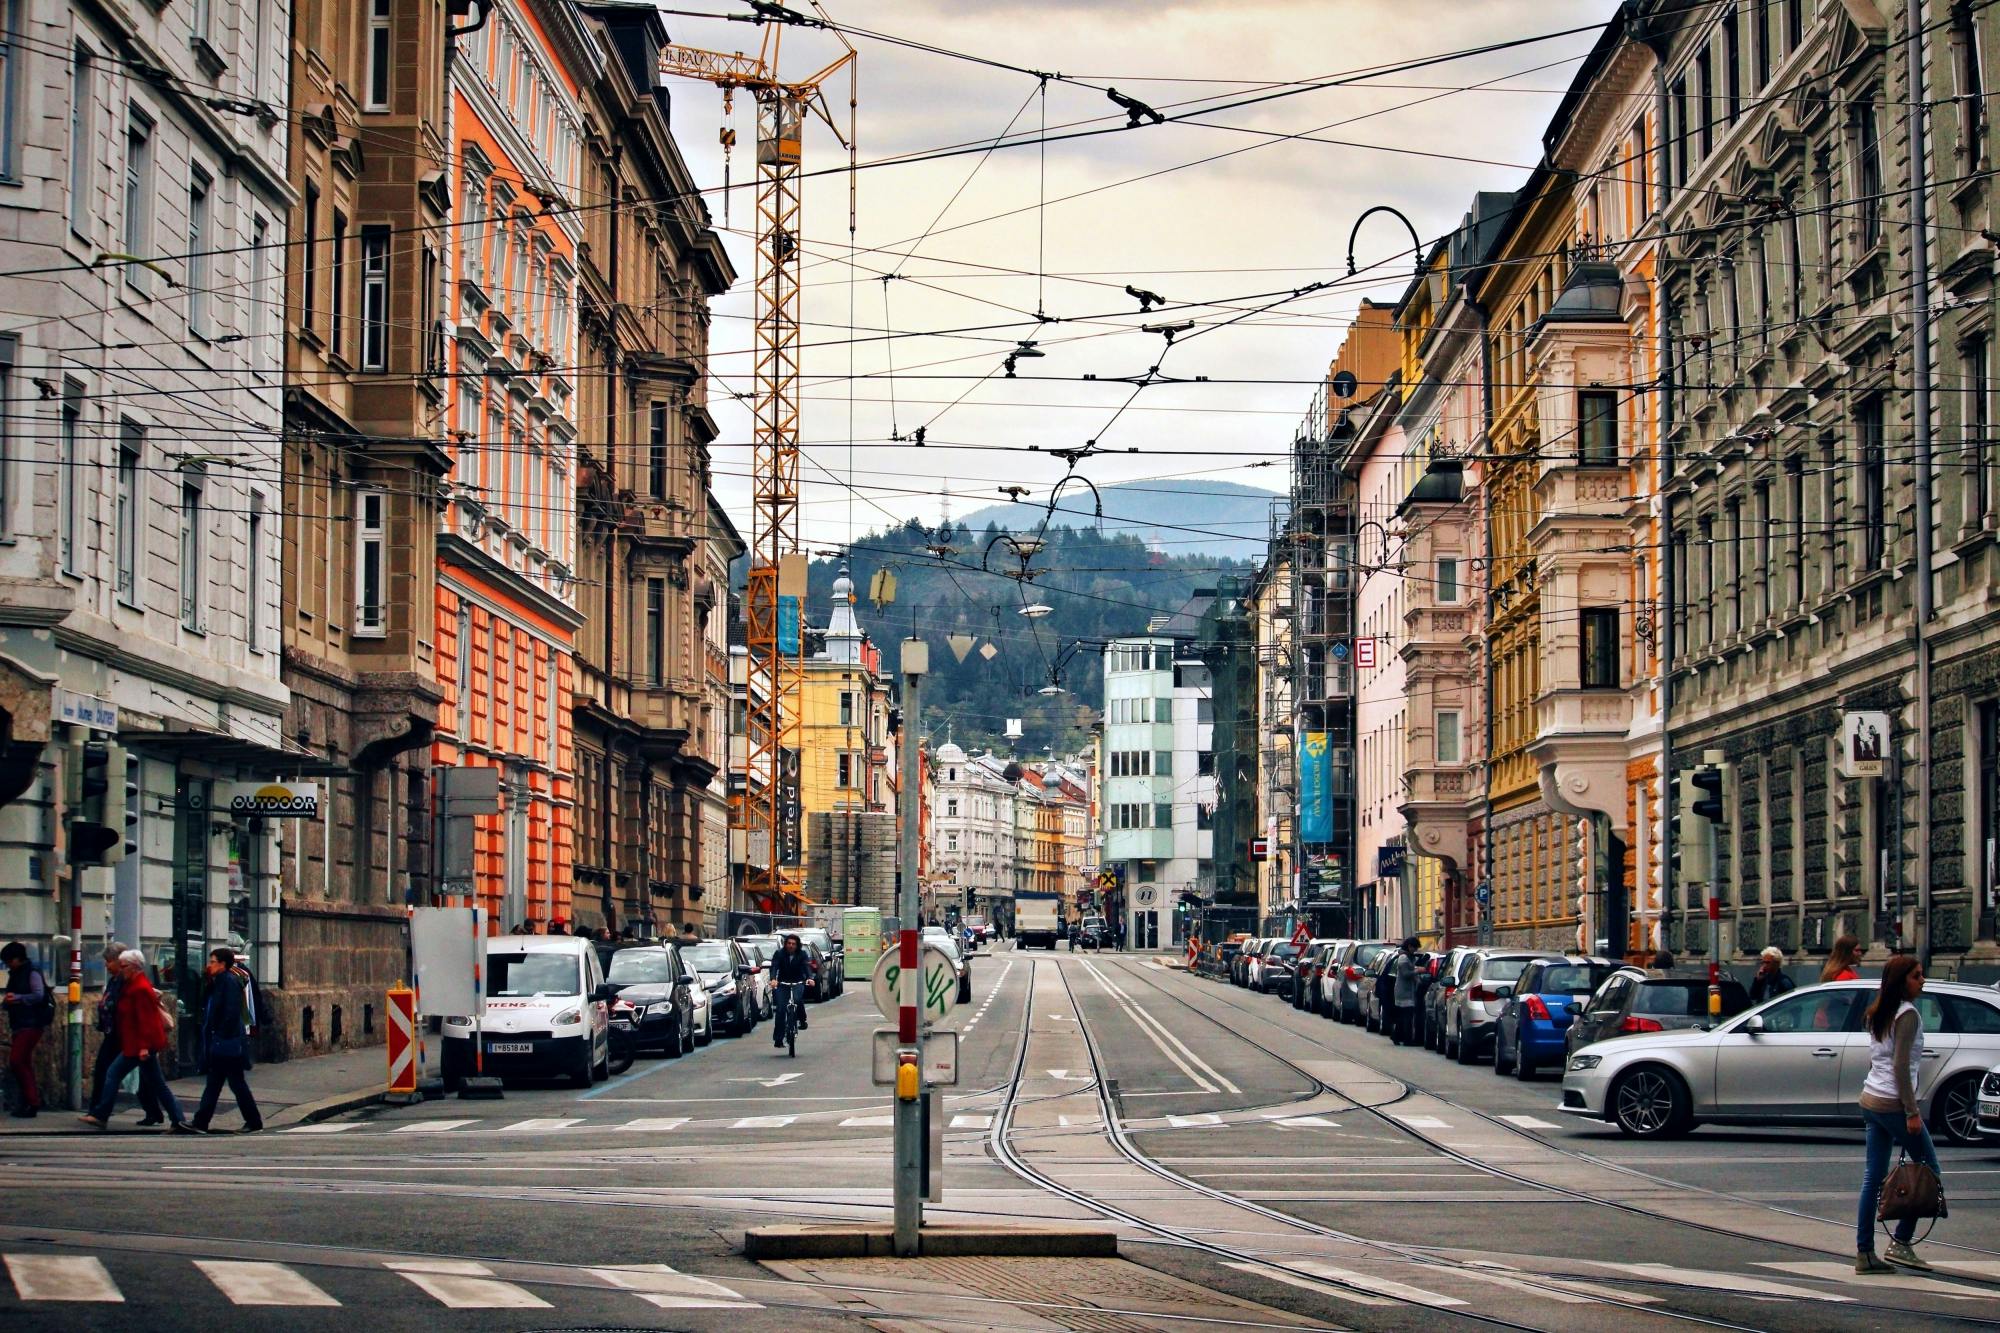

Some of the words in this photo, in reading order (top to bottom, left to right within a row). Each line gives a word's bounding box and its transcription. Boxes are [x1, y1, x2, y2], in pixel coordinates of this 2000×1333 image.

[1359, 643, 1372, 663] E
[232, 795, 315, 810] OUTDOOR
[786, 786, 795, 861] umfeld
